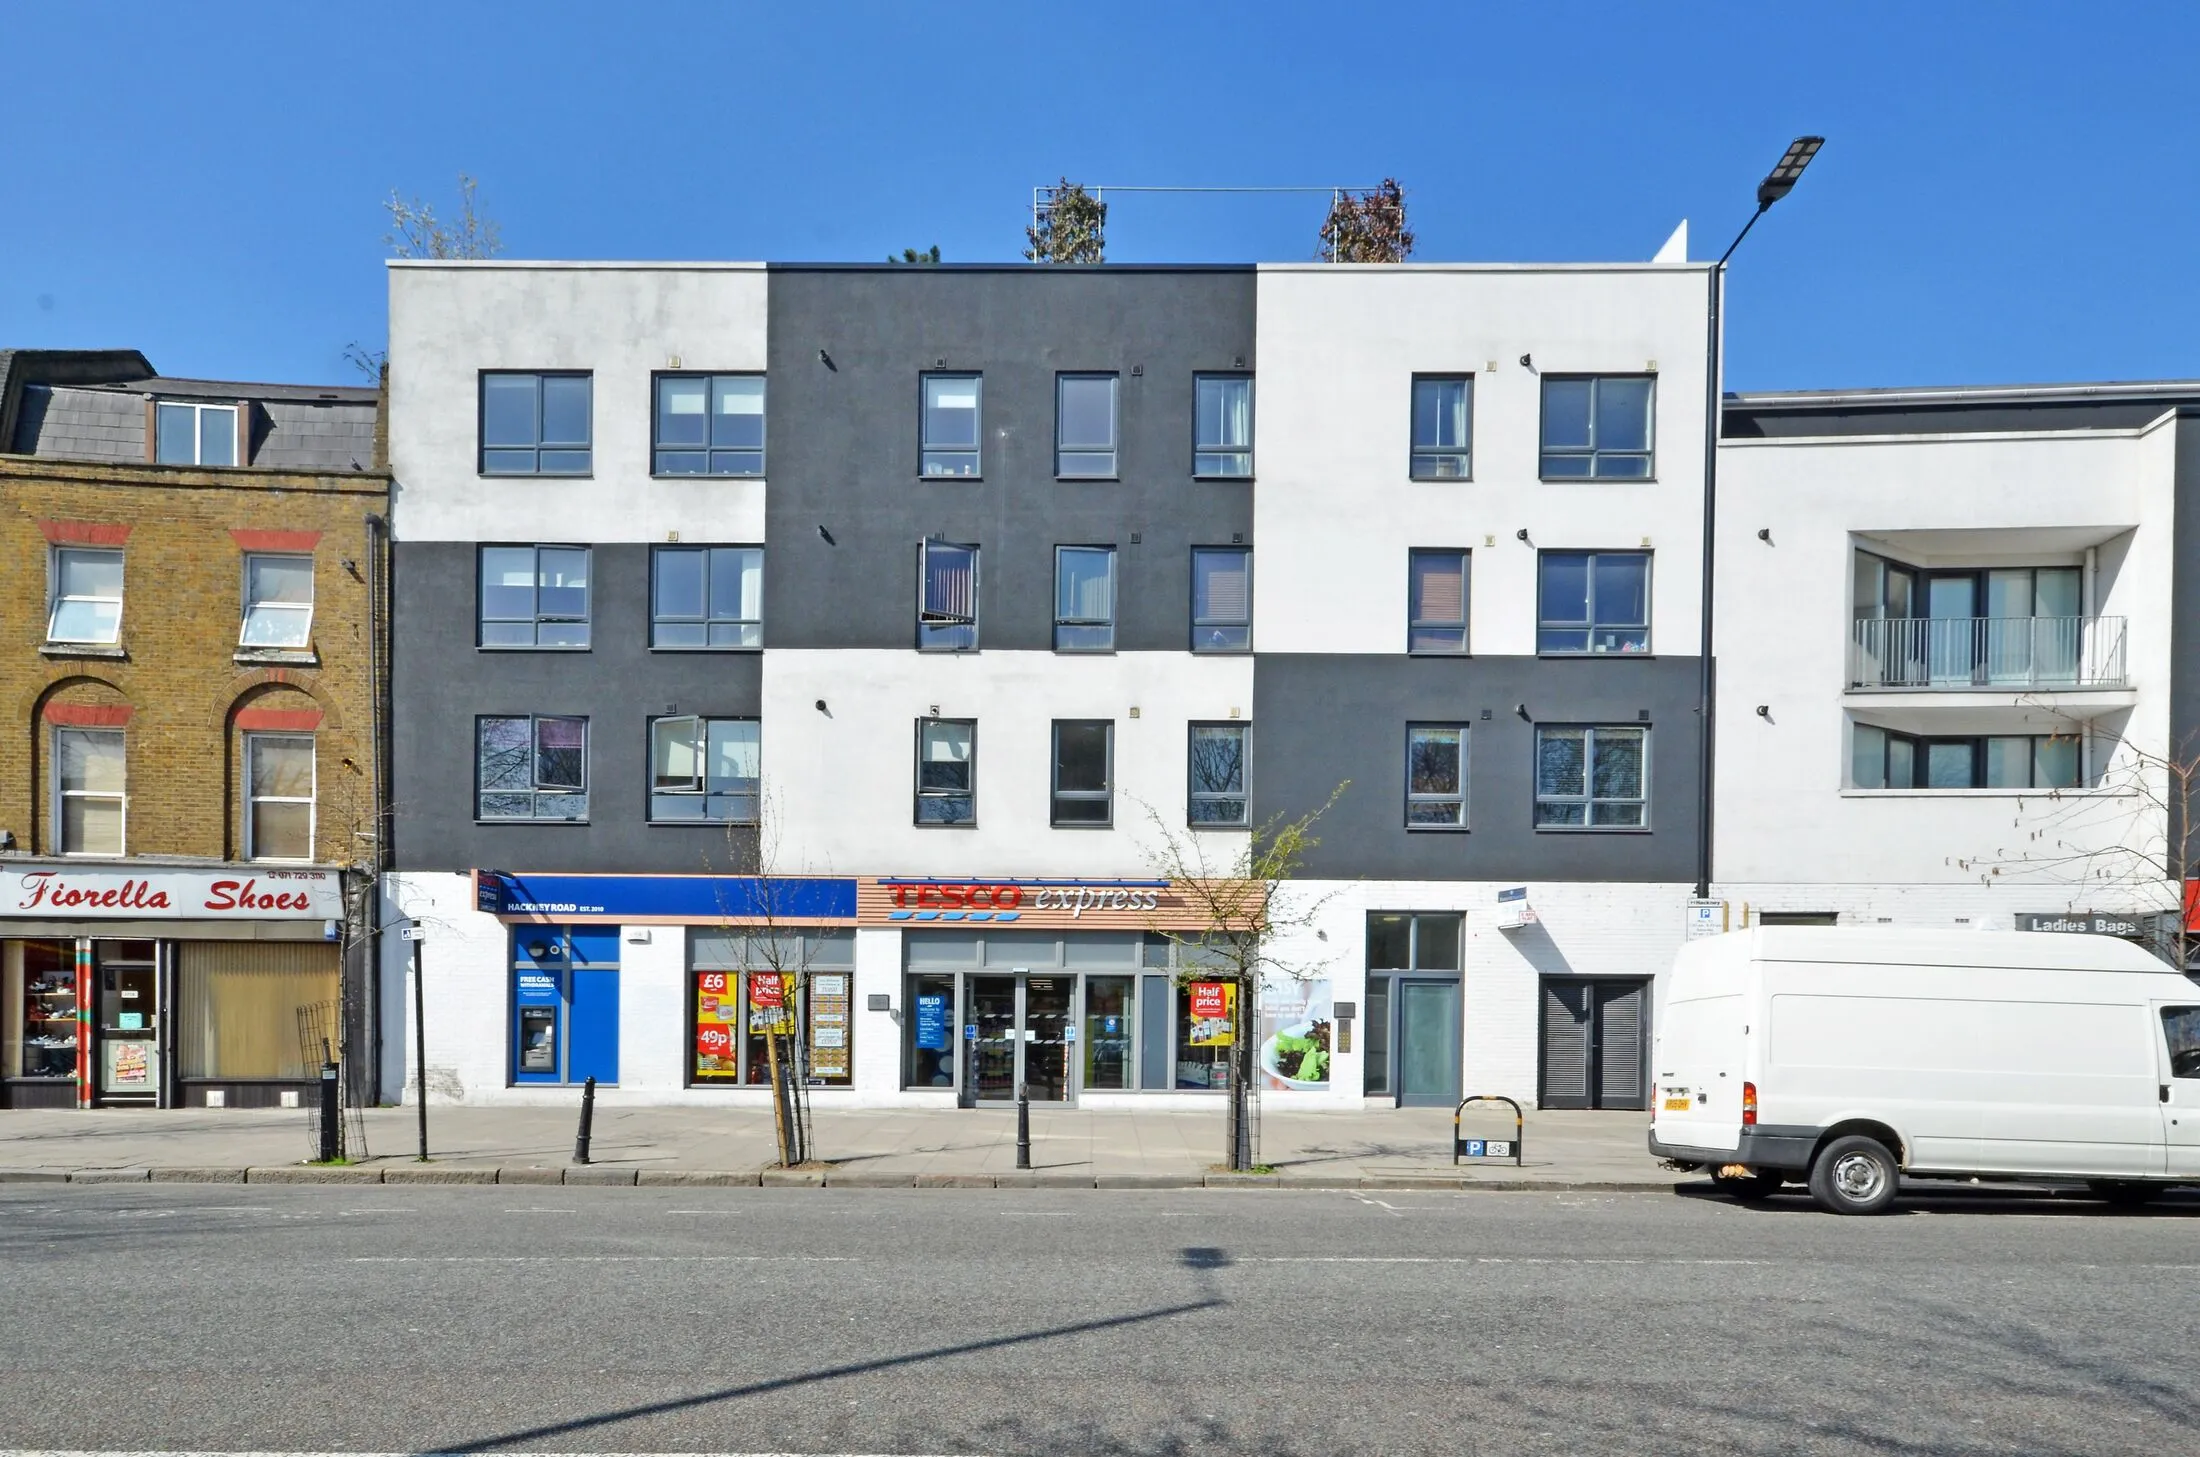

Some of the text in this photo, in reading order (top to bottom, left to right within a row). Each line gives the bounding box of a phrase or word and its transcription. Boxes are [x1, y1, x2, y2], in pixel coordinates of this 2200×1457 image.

[19, 871, 310, 910] Fiorella Shoes
[507, 903, 551, 912] HACKNEY
[551, 903, 577, 912] ROAD
[887, 884, 1158, 919] TESCO express
[2032, 918, 2136, 934] Ladies Bags
[704, 974, 724, 988] £6
[757, 975, 779, 985] Half
[755, 985, 780, 996] price
[1198, 987, 1220, 997] Half
[919, 997, 940, 1005] HELLO
[1196, 997, 1221, 1008] price
[701, 1030, 727, 1046] 49p
[1470, 1141, 1481, 1155] P
